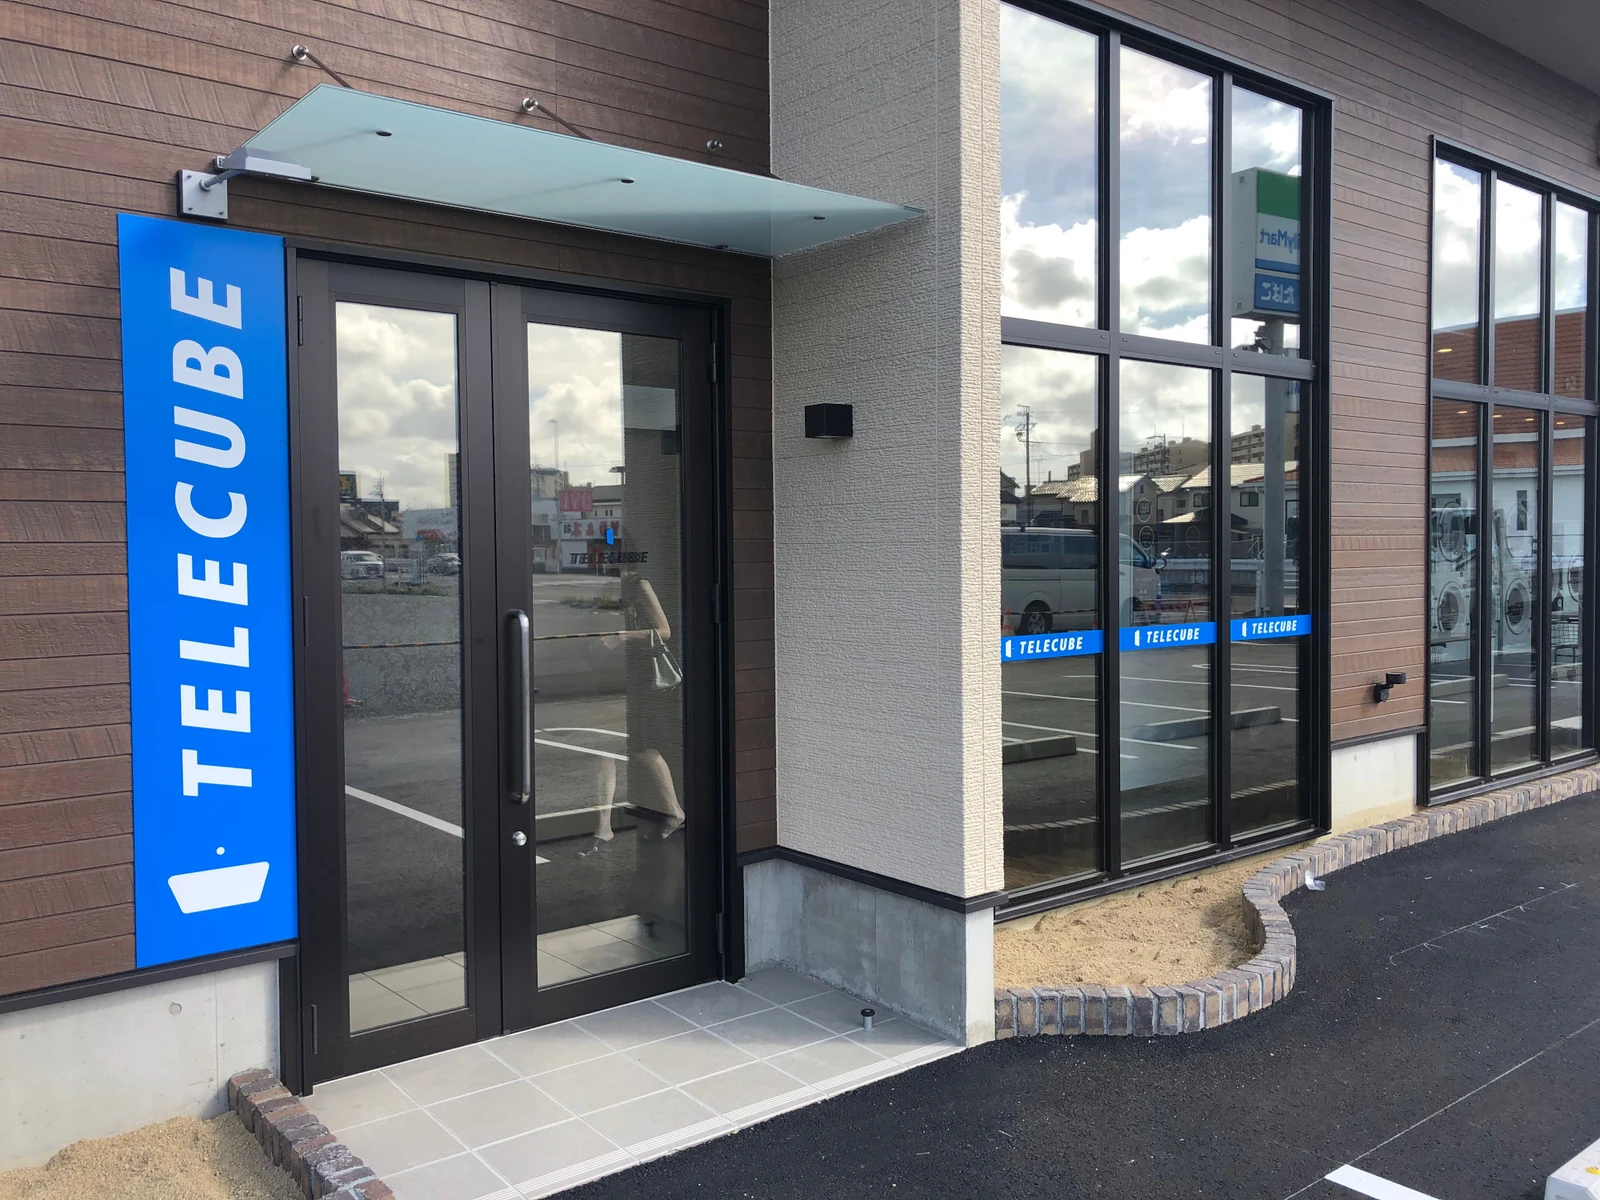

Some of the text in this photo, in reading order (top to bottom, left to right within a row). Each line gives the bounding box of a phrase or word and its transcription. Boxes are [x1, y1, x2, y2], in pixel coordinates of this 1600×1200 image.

[169, 267, 253, 797] TELECUBE
[1251, 619, 1298, 635] TELECUBE
[1146, 628, 1200, 644] TELECUBE
[1019, 636, 1083, 655] TELECUBE
